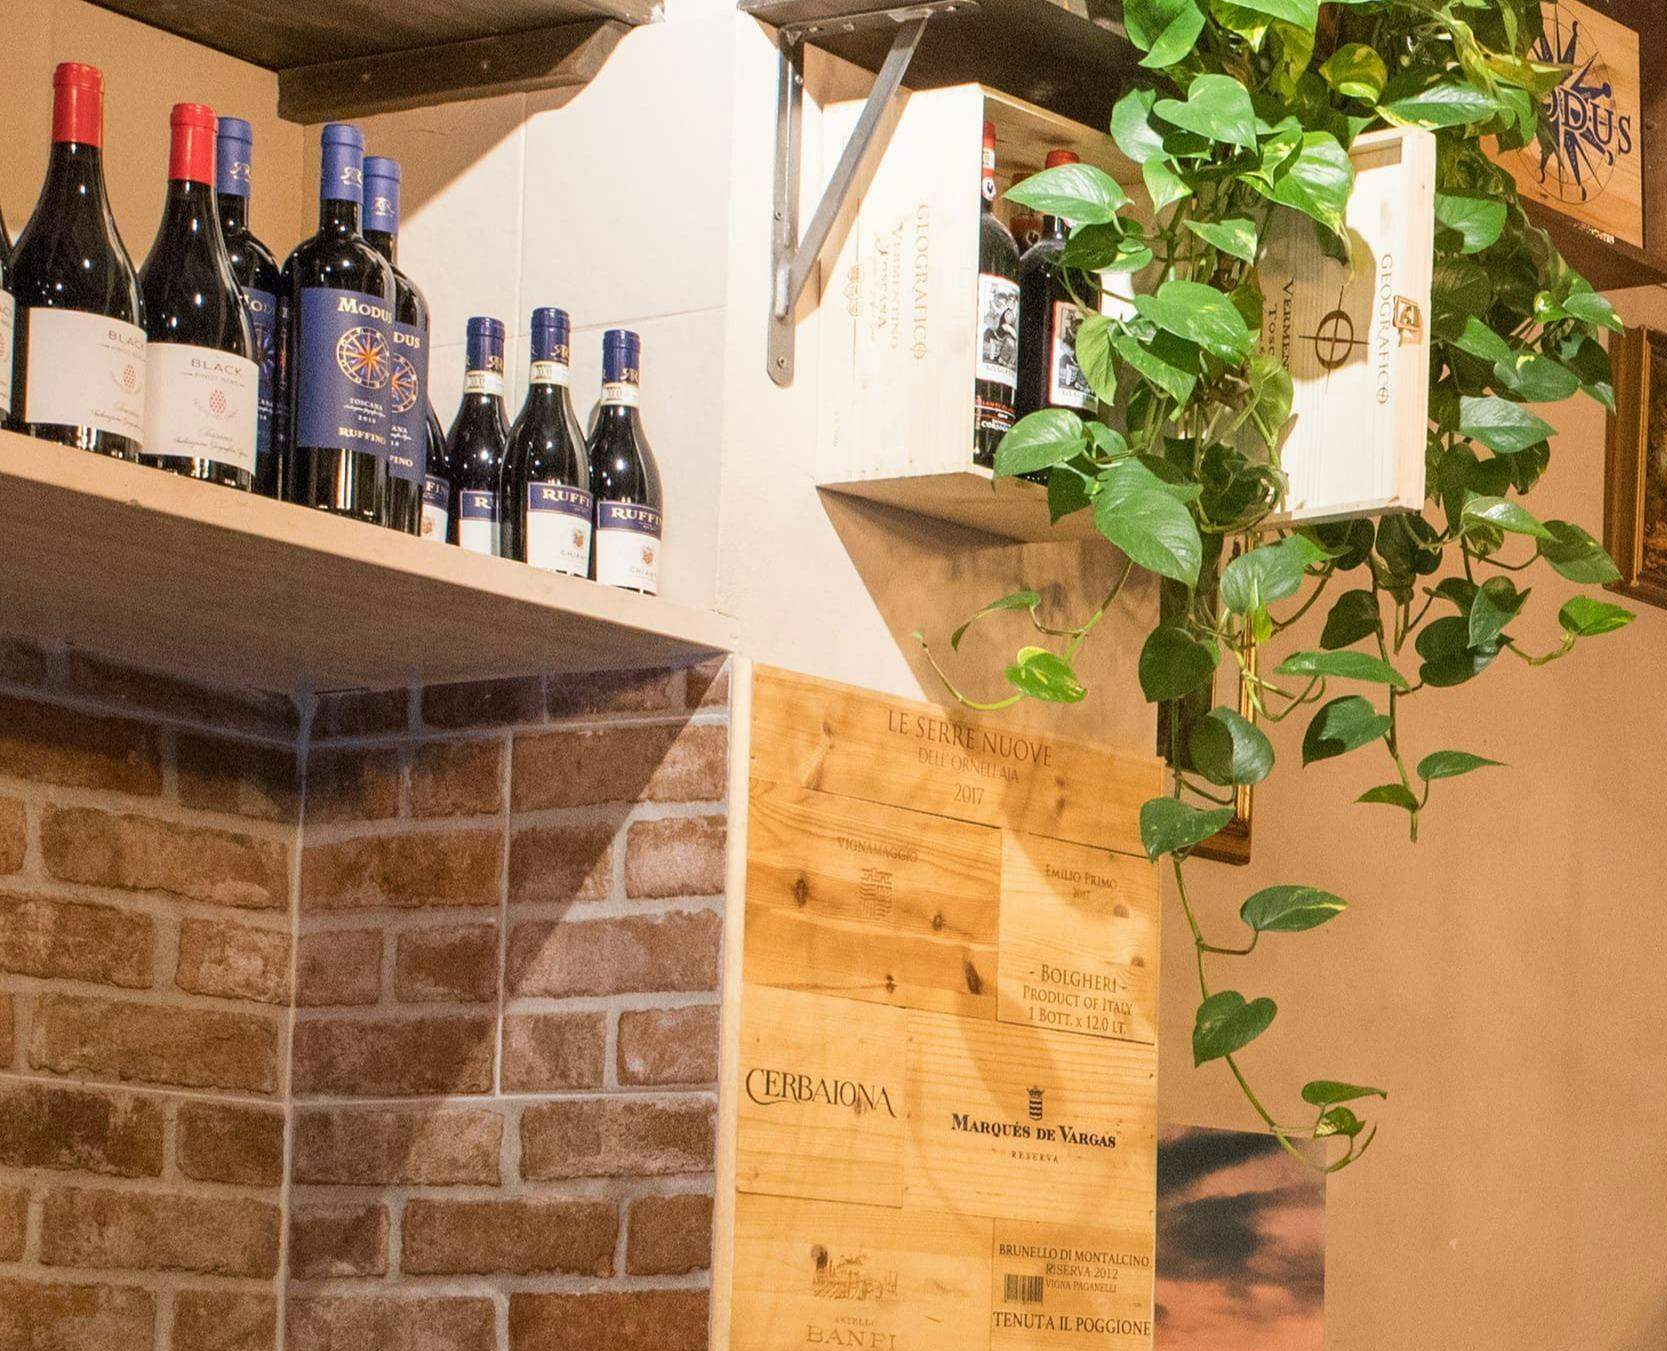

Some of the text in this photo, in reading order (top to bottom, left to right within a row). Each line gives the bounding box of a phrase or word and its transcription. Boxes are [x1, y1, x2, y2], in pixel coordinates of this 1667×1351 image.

[912, 203, 929, 360] GEOGRAFICO
[1266, 304, 1278, 357] TOSC
[1377, 254, 1393, 405] GEOGRAFICO
[191, 357, 242, 376] BLACK
[888, 710, 1053, 767] LE SERRE NUOVE
[951, 754, 1020, 784] ORNELLAIA
[953, 783, 985, 806] 2017
[1041, 963, 1117, 994] BOLGHERI
[1023, 984, 1134, 1016] PRODUCT OF ITALY
[1029, 1006, 1035, 1021] 1
[1087, 1014, 1109, 1032] 12.0
[745, 1067, 897, 1119] CERBAIONA
[1036, 1128, 1057, 1142] DE
[1059, 1124, 1117, 1149] VARGAS
[1011, 1150, 1060, 1164] RESERVA
[999, 1243, 1059, 1261] BRUNELLO
[1060, 1249, 1073, 1261] DI
[1046, 1263, 1119, 1280] RISERVA 2012
[1046, 1279, 1072, 1291] VIGNA
[993, 1311, 1152, 1336] TENUTA IL POGGIONE
[806, 1324, 897, 1351] BANFI
